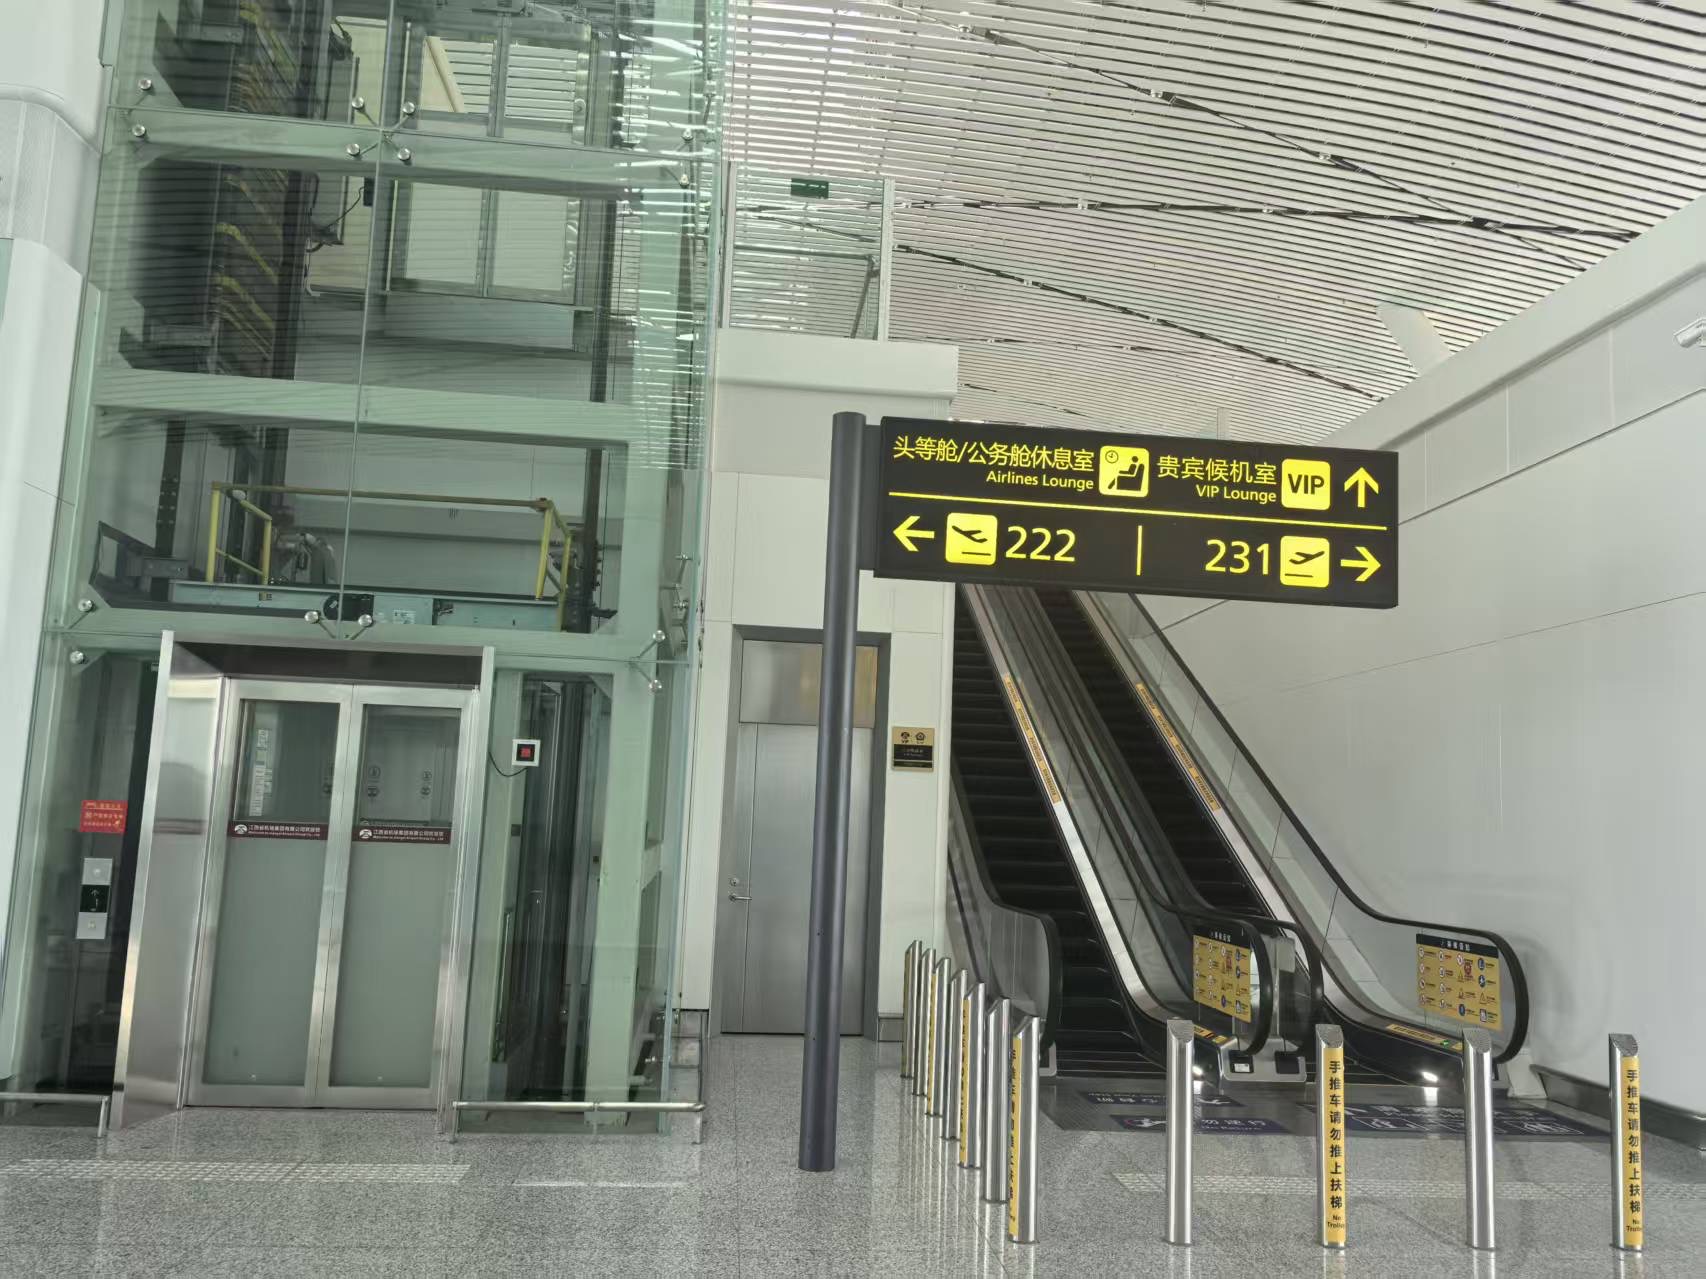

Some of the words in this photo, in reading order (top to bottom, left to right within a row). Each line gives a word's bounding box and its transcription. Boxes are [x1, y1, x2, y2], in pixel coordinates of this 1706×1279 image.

[893, 435, 1094, 472] 头等舱/公务舱休息室
[1157, 455, 1277, 485] 贵宾候机室
[986, 470, 1039, 486] Airlines
[1042, 473, 1094, 491] Lounge
[1195, 484, 1220, 498] VIP
[1223, 486, 1277, 504] Lounge
[1287, 473, 1325, 495] VIP
[1005, 525, 1076, 562] 222
[1205, 539, 1270, 575] 231
[1329, 1060, 1343, 1209] 手推车请勿推上扶梯
[1626, 1069, 1641, 1213] 手推车请勿推上扶梯
